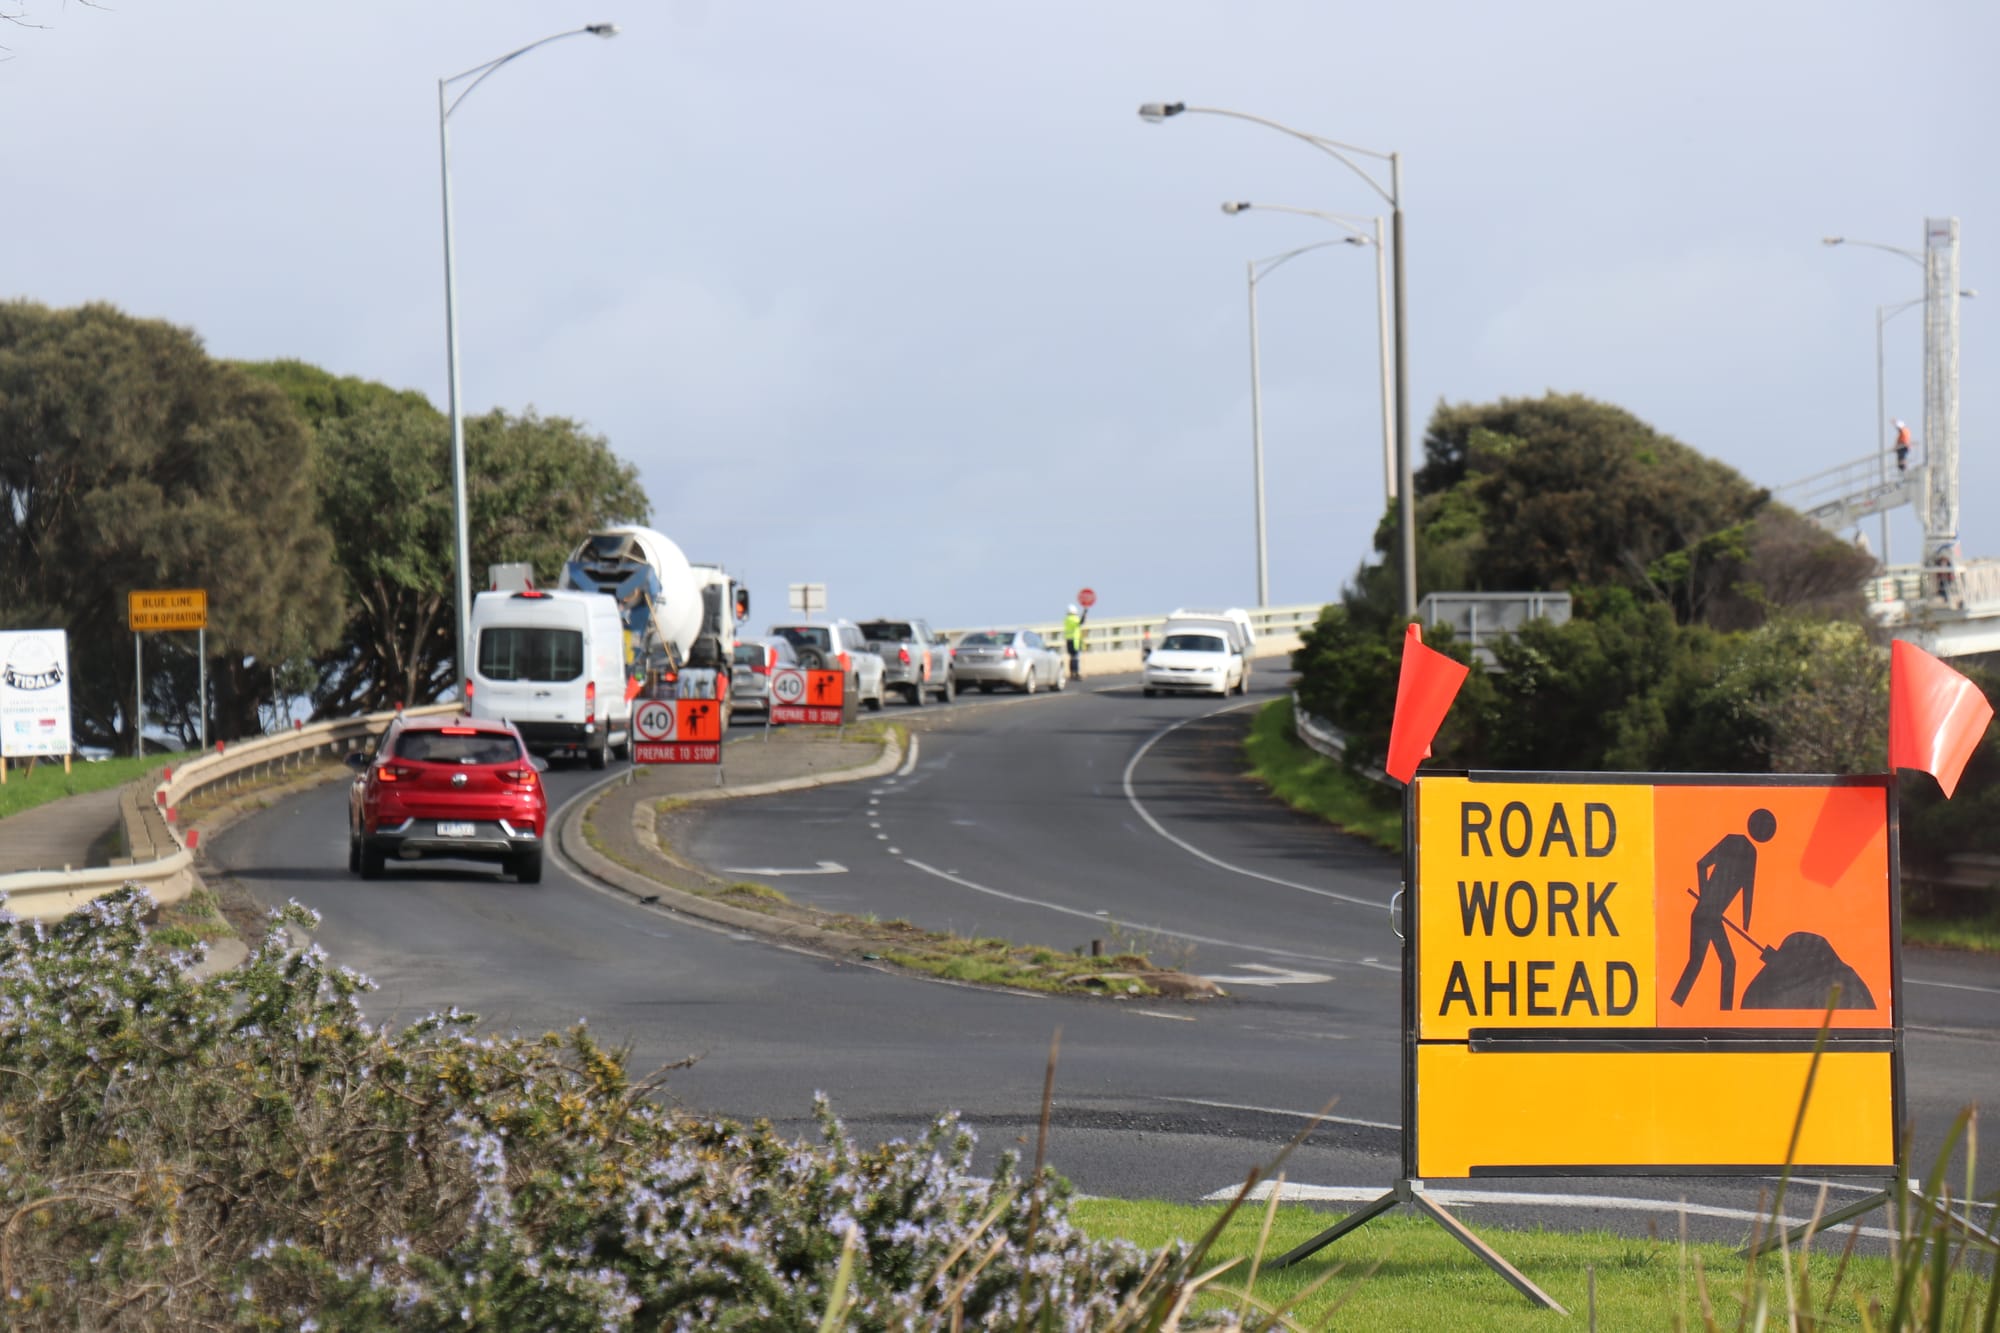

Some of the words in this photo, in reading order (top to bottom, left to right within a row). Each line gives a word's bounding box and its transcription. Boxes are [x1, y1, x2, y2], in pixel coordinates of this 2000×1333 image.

[142, 597, 166, 608] BLUE
[171, 596, 192, 607] LINE
[133, 613, 148, 624] NOT
[161, 611, 201, 623] OPERATION
[13, 672, 54, 689] TIDAL
[778, 679, 800, 695] 40
[642, 711, 668, 730] 40
[772, 709, 804, 721] PREPARE
[808, 709, 818, 721] TO
[820, 710, 840, 722] STOP
[636, 747, 675, 760] PREPARE
[679, 747, 690, 760] TO
[693, 747, 716, 760] STOP
[1459, 800, 1617, 858] ROAD
[1456, 880, 1620, 937] WORK
[1438, 960, 1639, 1017] AHEAD
